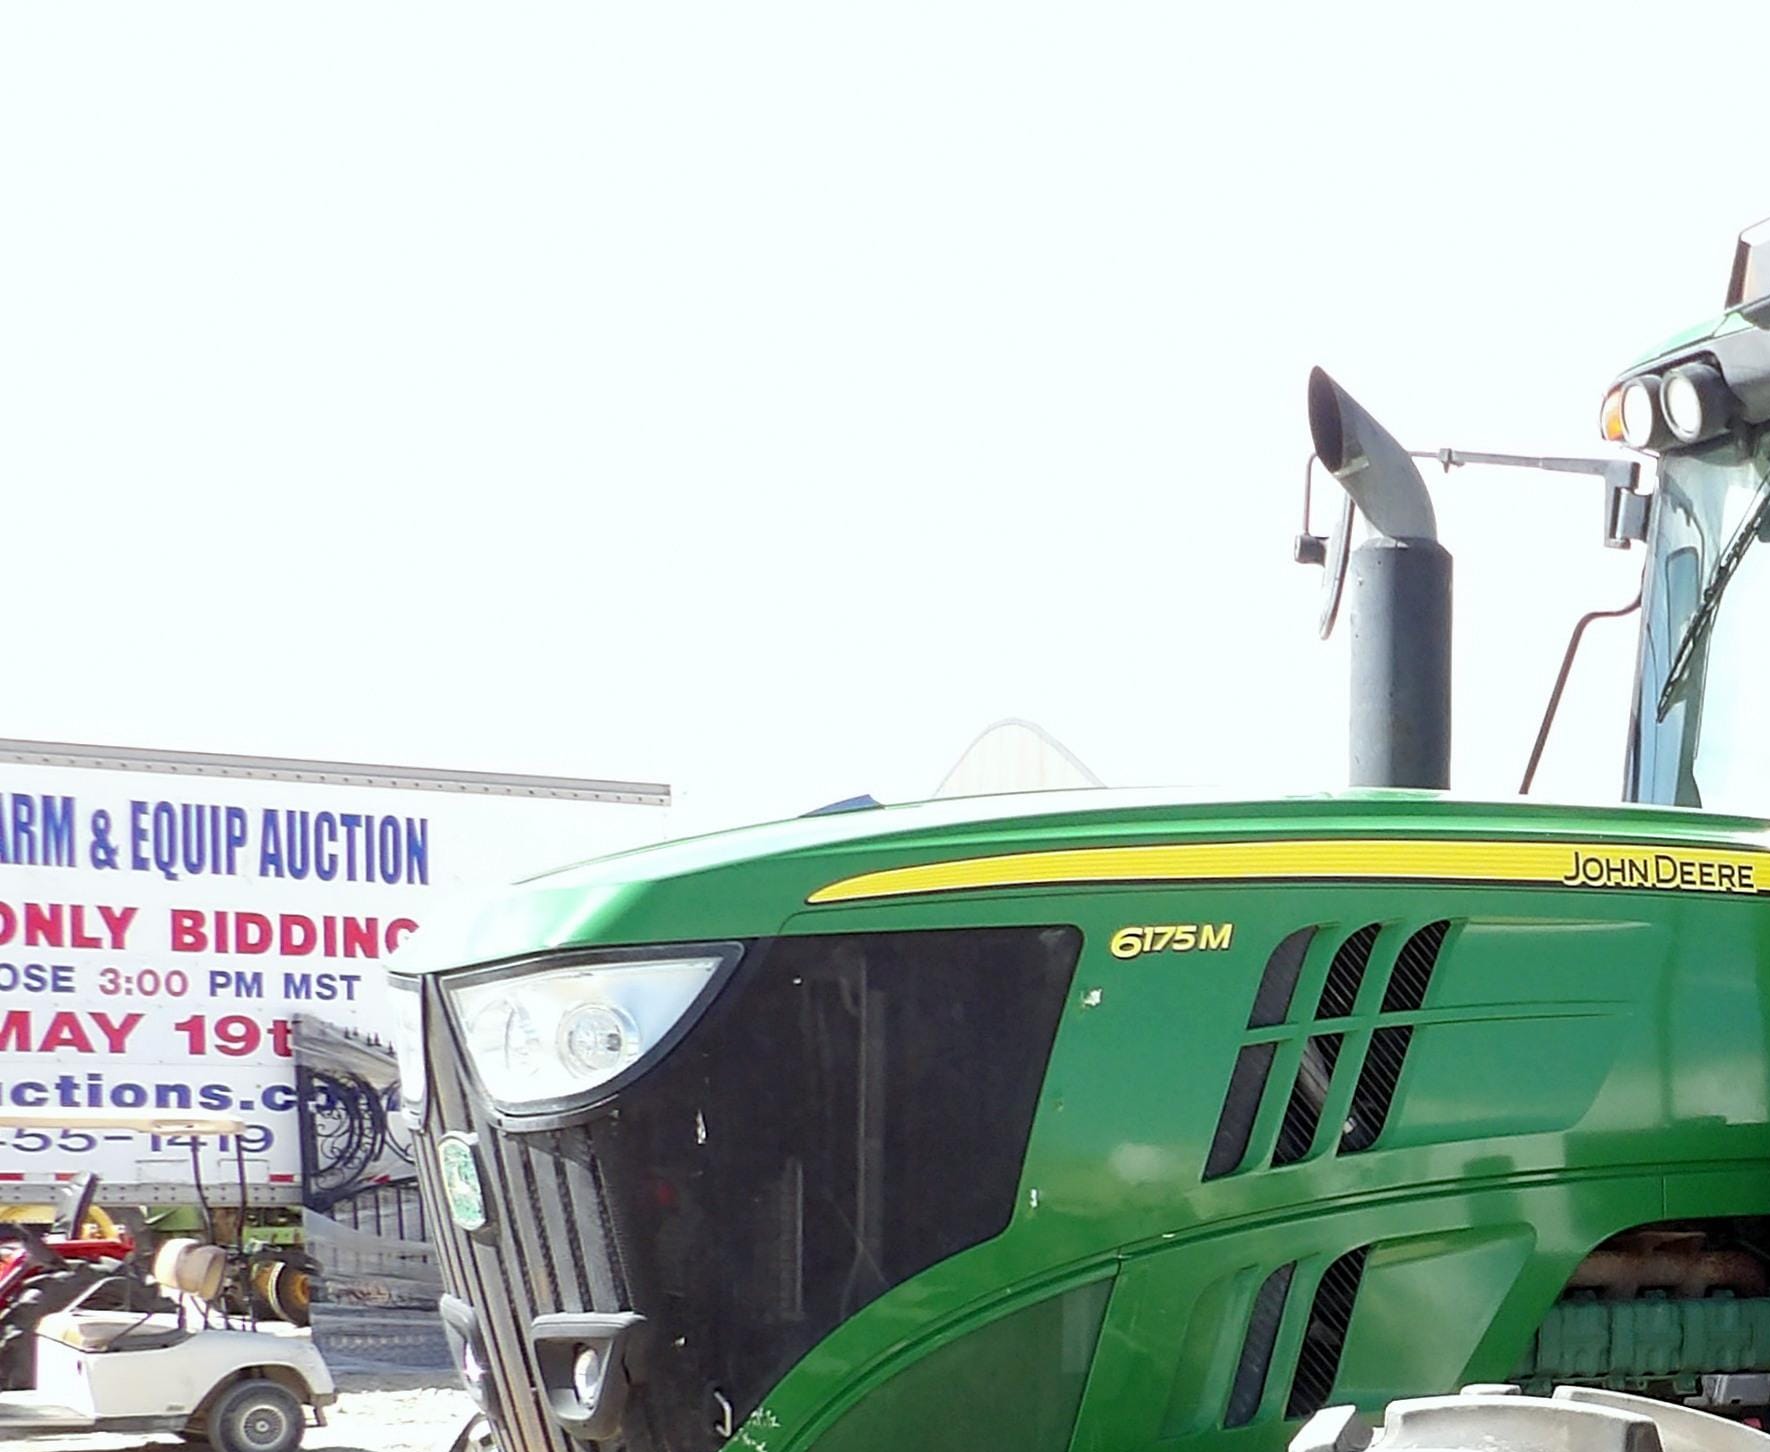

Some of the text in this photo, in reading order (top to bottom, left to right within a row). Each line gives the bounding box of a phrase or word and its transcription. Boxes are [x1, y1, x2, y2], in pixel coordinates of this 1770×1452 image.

[89, 808, 120, 870] &
[130, 799, 248, 882] EQUIP
[259, 807, 430, 886] AUCTION
[1564, 851, 1756, 890] JOHN DEERE
[1110, 923, 1233, 959] 6175M
[99, 967, 189, 998] 3:00
[209, 969, 264, 999] PM
[284, 972, 362, 1002] MST
